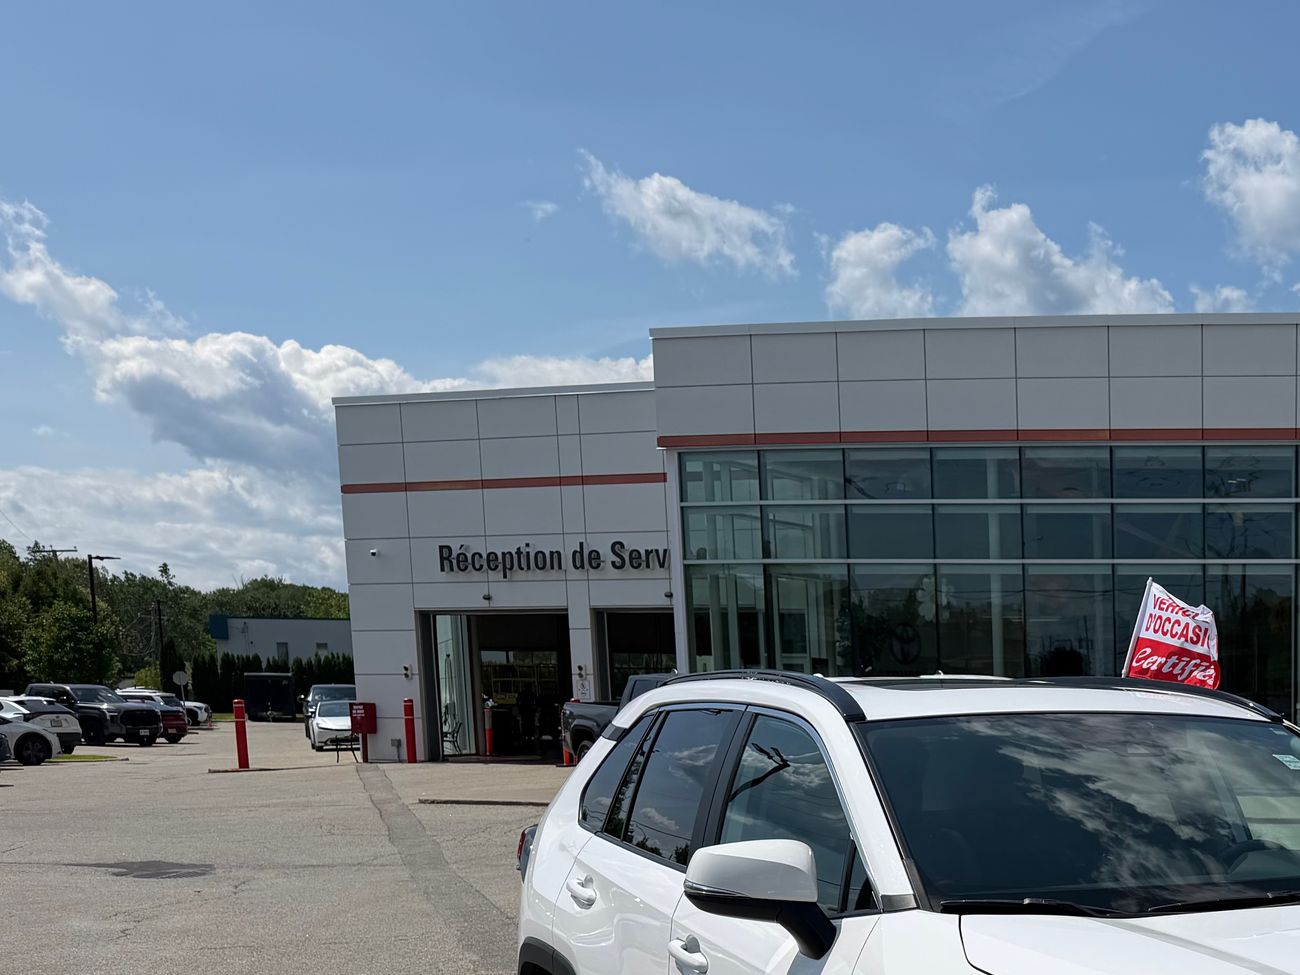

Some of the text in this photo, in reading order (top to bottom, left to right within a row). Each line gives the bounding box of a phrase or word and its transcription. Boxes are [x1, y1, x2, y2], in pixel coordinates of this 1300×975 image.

[438, 540, 669, 579] Réception de Serv
[1145, 613, 1210, 649] D'OCCASI
